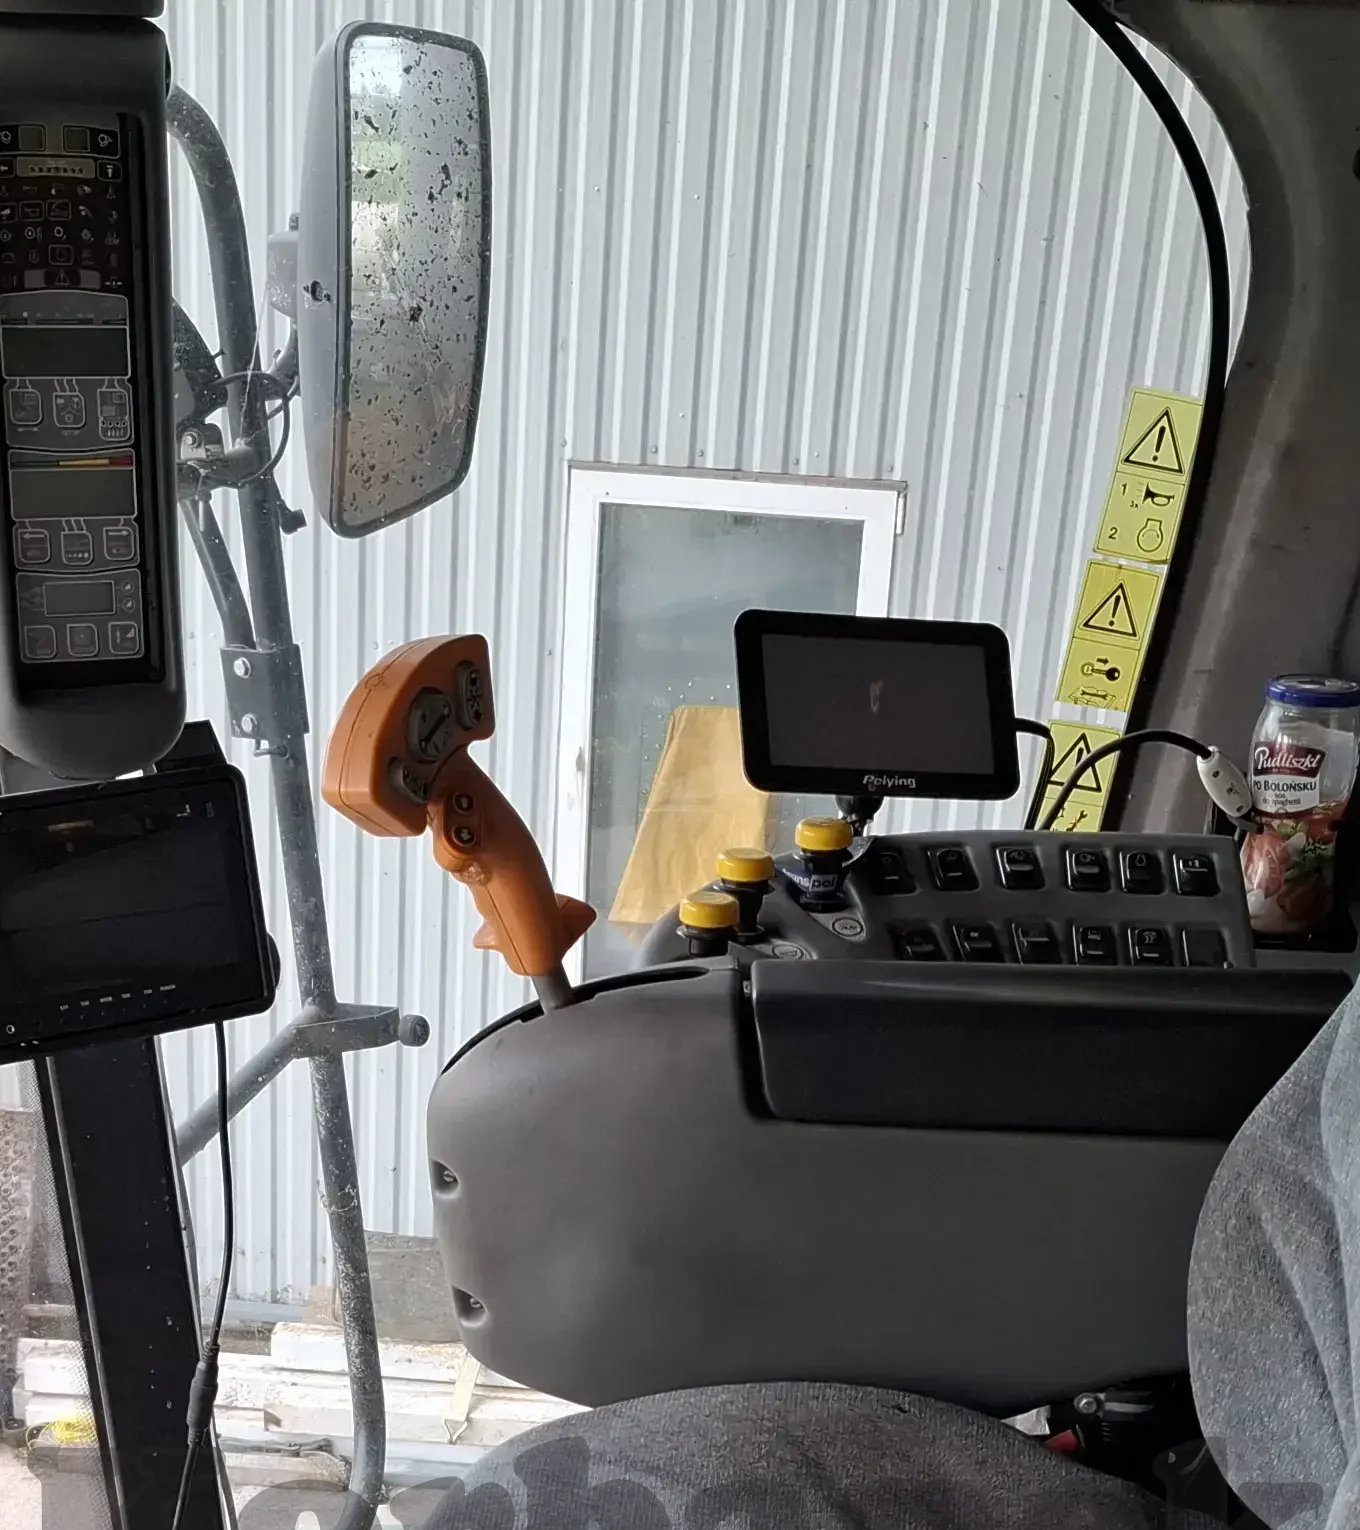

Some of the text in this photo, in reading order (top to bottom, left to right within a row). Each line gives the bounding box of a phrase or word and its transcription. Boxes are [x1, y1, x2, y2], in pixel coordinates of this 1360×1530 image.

[1121, 482, 1128, 496] 1
[1108, 527, 1118, 540] 2
[1254, 746, 1321, 770] Pudliszki
